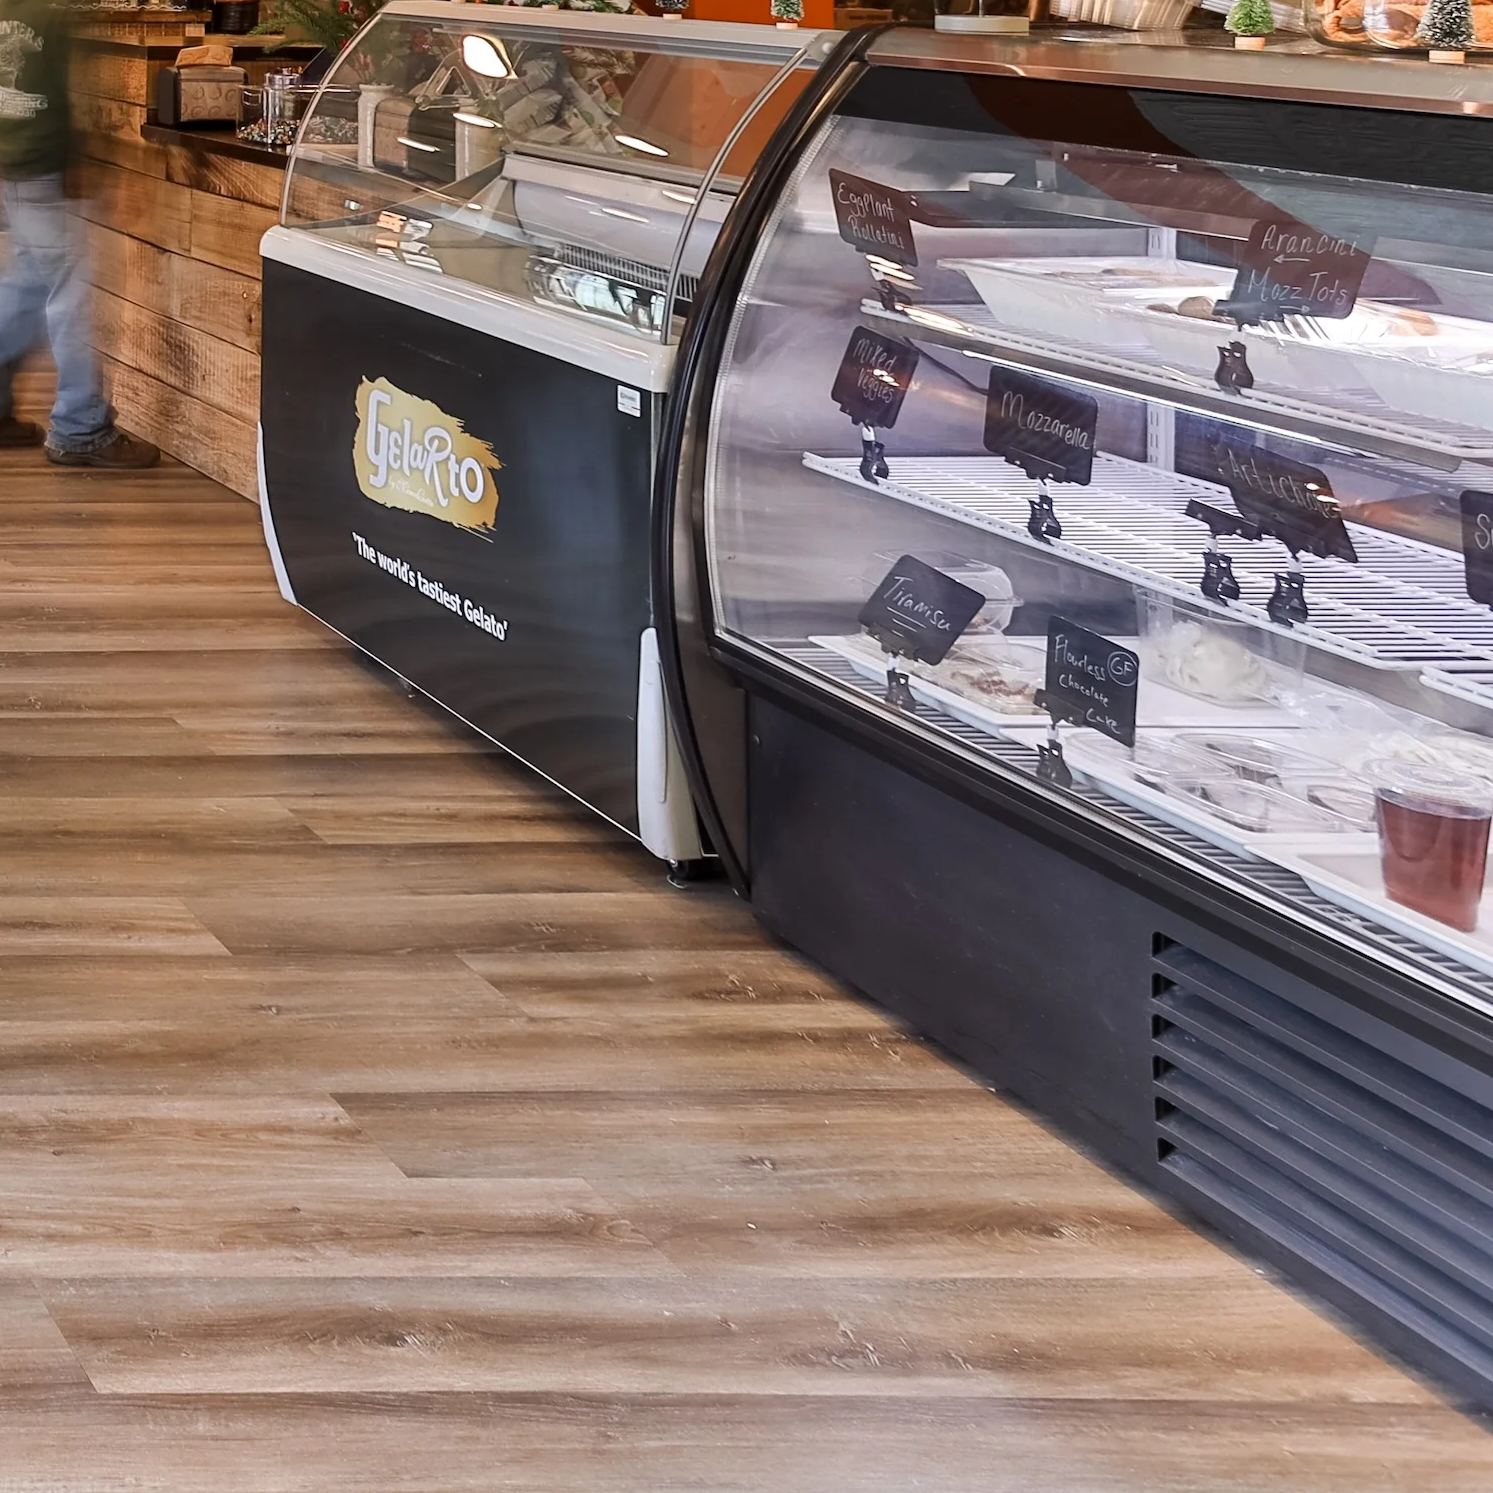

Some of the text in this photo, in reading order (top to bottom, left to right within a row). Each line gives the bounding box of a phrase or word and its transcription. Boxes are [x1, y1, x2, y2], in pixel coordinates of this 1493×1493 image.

[1261, 224, 1358, 257] Arancini
[1247, 267, 1348, 306] Mozz Tots
[853, 338, 897, 372] Mixed
[857, 367, 894, 404] Veggies
[1001, 391, 1091, 450] Mozzarella
[377, 551, 416, 588] world's
[417, 571, 463, 616] tastiest
[883, 575, 951, 632] Tiramisu
[1054, 633, 1133, 682] Flourless GF
[1058, 673, 1110, 708] Chocolate
[1085, 708, 1122, 735] Cake
